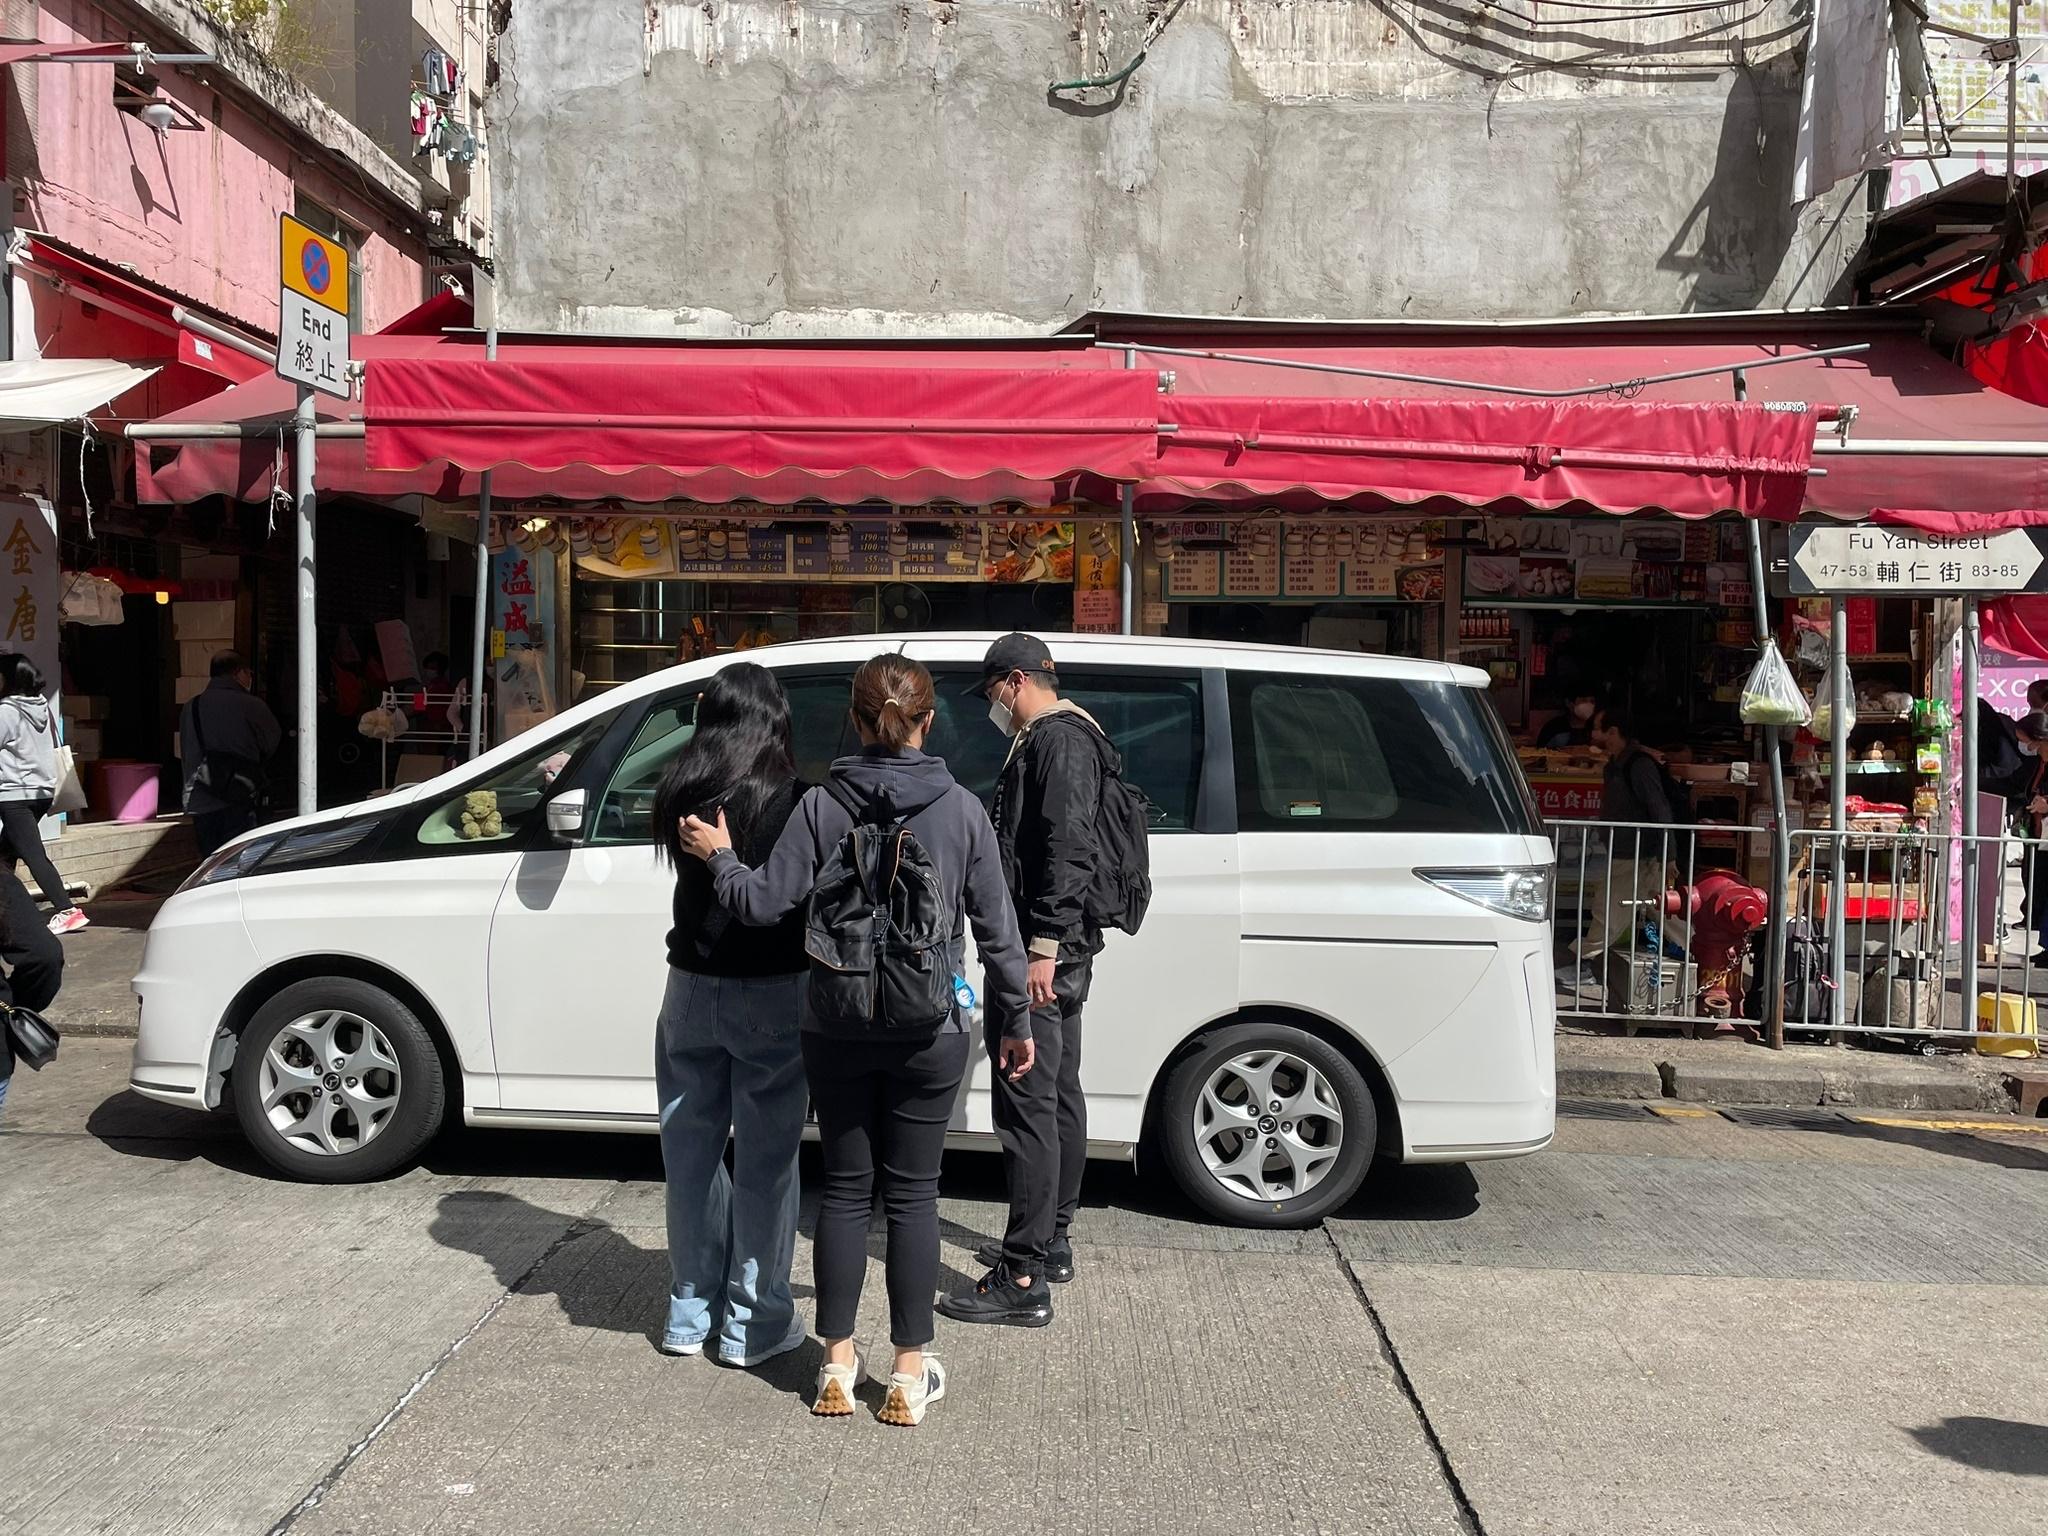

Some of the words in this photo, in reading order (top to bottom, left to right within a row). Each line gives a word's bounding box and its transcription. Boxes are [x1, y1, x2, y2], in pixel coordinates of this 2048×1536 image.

[302, 307, 331, 341] End
[295, 339, 337, 383] 終止
[1848, 533, 1873, 550] Fu
[1881, 533, 1919, 550] Yan
[1927, 533, 1989, 550] Street
[2, 517, 42, 642] 金唐
[1820, 564, 1868, 577] 47-53
[1876, 561, 1962, 583] 輔仁街
[1972, 564, 2019, 577] 83-85
[1979, 654, 2002, 666] 交收
